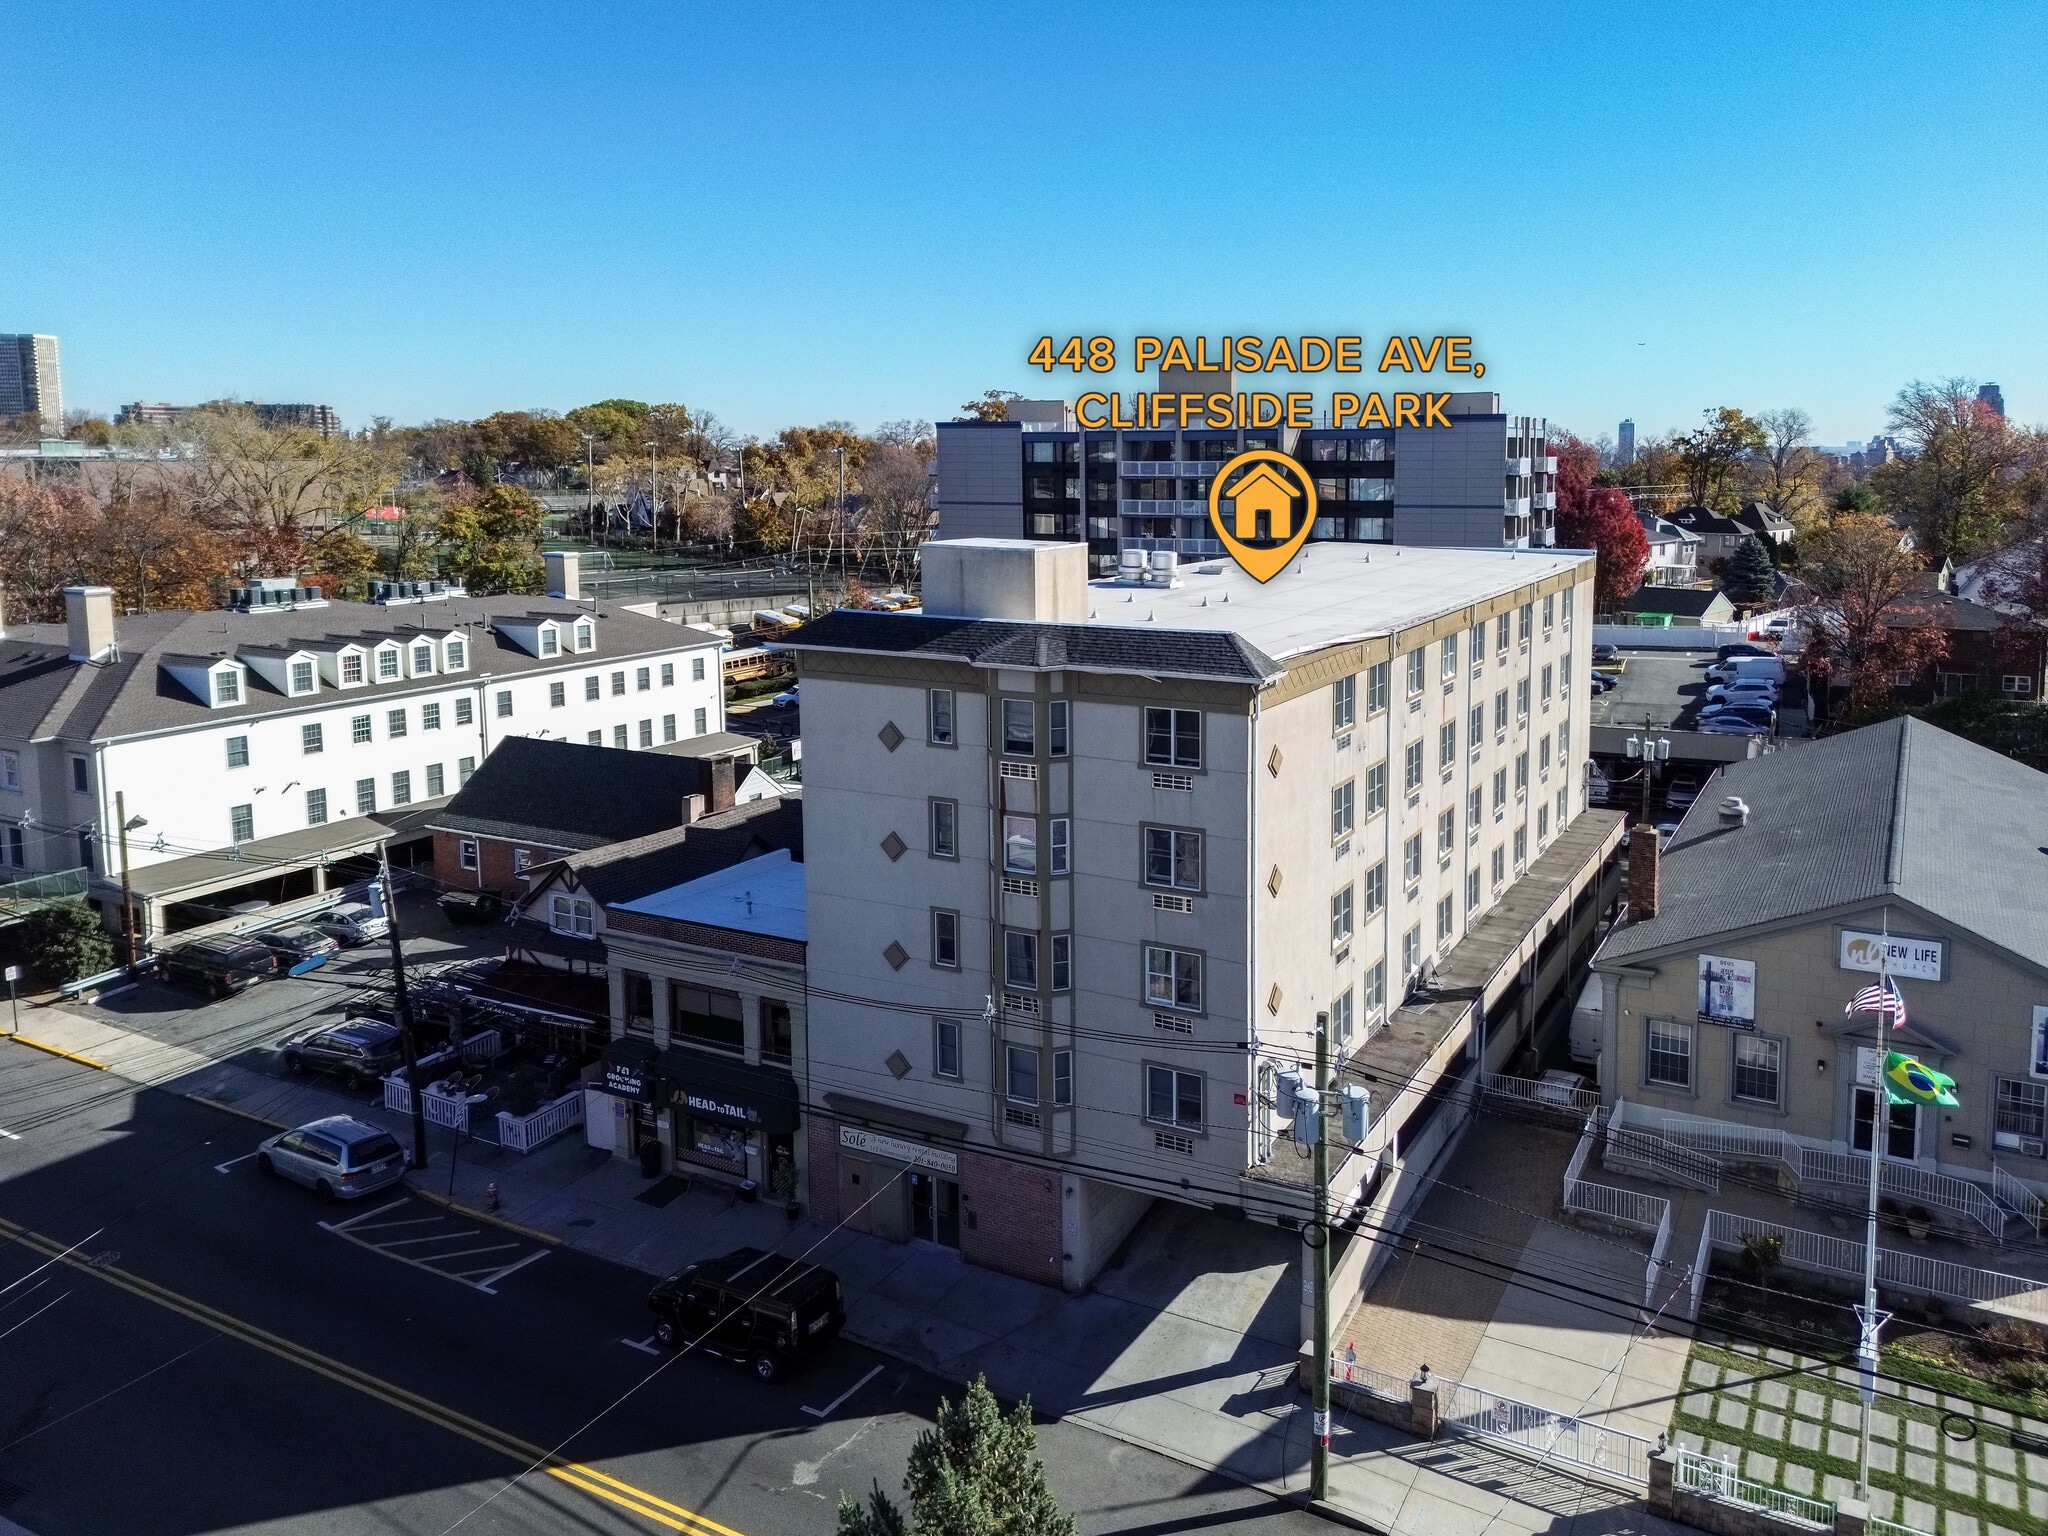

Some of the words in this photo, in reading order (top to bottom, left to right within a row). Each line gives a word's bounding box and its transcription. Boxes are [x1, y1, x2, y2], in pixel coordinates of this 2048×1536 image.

[1914, 948, 1937, 963] LIFE
[1885, 961, 1937, 974] HURCH
[608, 1081, 640, 1095] ACADEMY
[688, 1096, 717, 1111] HEAD
[724, 1104, 746, 1119] TAIL
